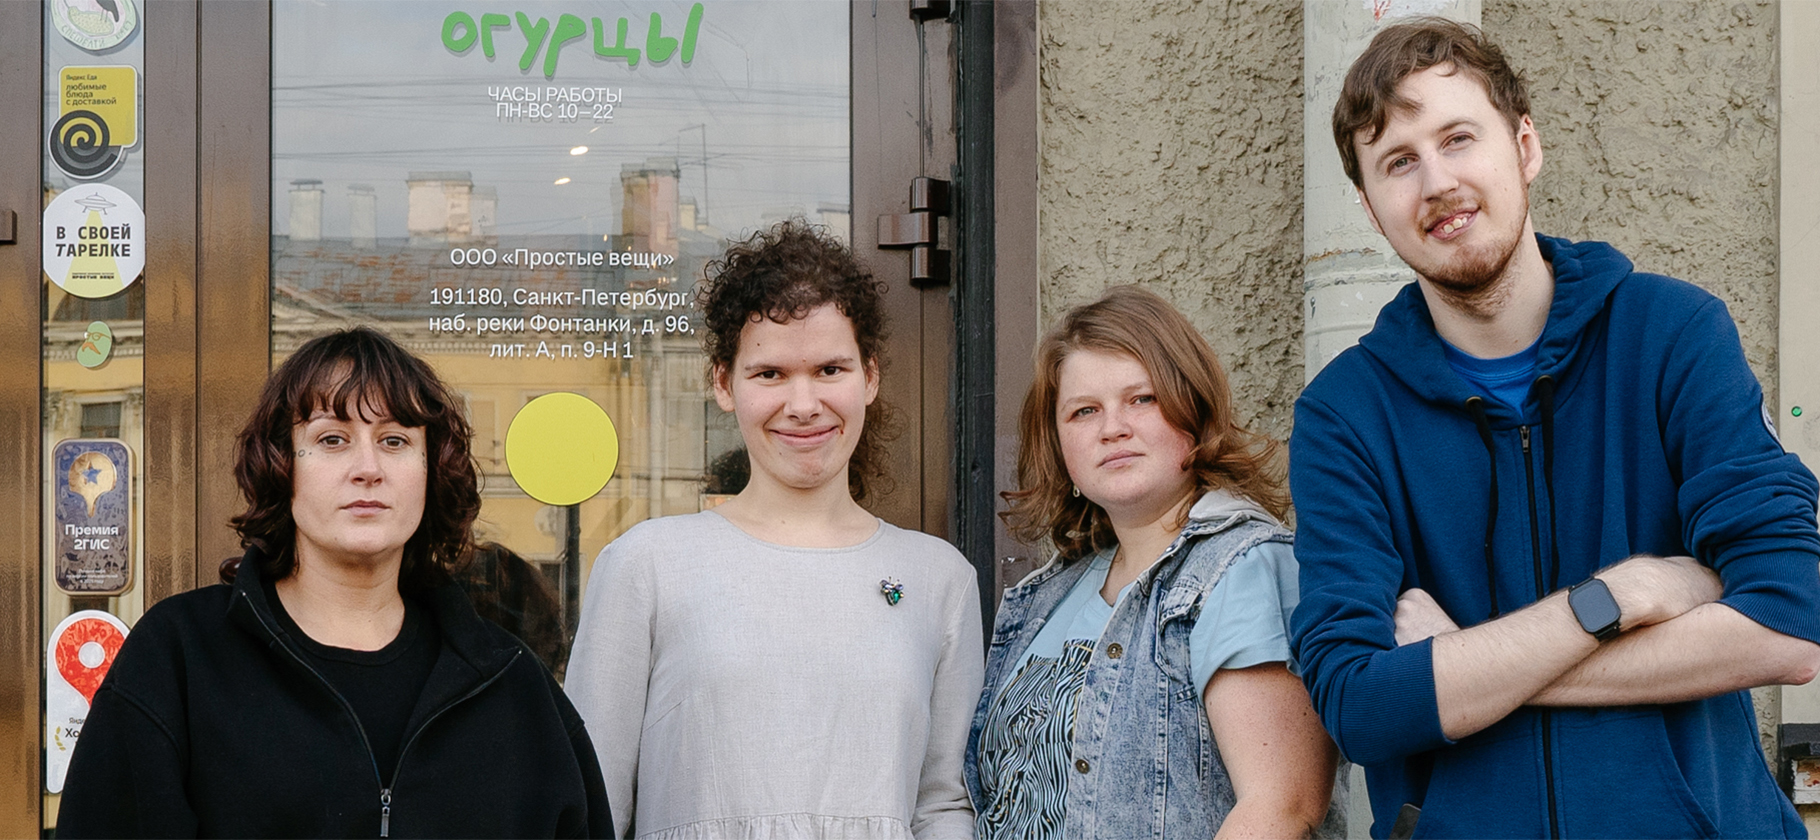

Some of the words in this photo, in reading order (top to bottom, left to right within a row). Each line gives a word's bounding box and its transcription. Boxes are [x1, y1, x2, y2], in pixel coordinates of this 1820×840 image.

[66, 83, 107, 91] любимые
[66, 90, 93, 98] блюда
[487, 86, 541, 102] ЧАСЫ
[546, 87, 622, 103] РАБОТЫ
[72, 97, 117, 106] доставкой
[496, 103, 553, 118] ПН-ВС
[56, 226, 66, 240] В
[77, 223, 131, 240] СВОЕЙ
[55, 243, 131, 257] ТАРЕЛКЕ
[450, 248, 497, 266] ООО
[502, 248, 604, 269] «Простые
[608, 250, 674, 269] вещи»
[429, 287, 508, 308] 191180,
[513, 288, 695, 310] Санкт-Петербург,
[428, 313, 471, 332] наб.
[476, 316, 525, 335] реки
[529, 314, 637, 335] Фонтанки,
[641, 317, 660, 336] д.
[664, 315, 695, 335] 96,
[489, 343, 530, 358] лит.
[535, 341, 556, 360] А,
[560, 343, 578, 358] п.
[582, 341, 617, 358] 9-Н
[622, 341, 634, 358] 1
[65, 524, 119, 538] Премия
[73, 538, 110, 550] 2ГИС
